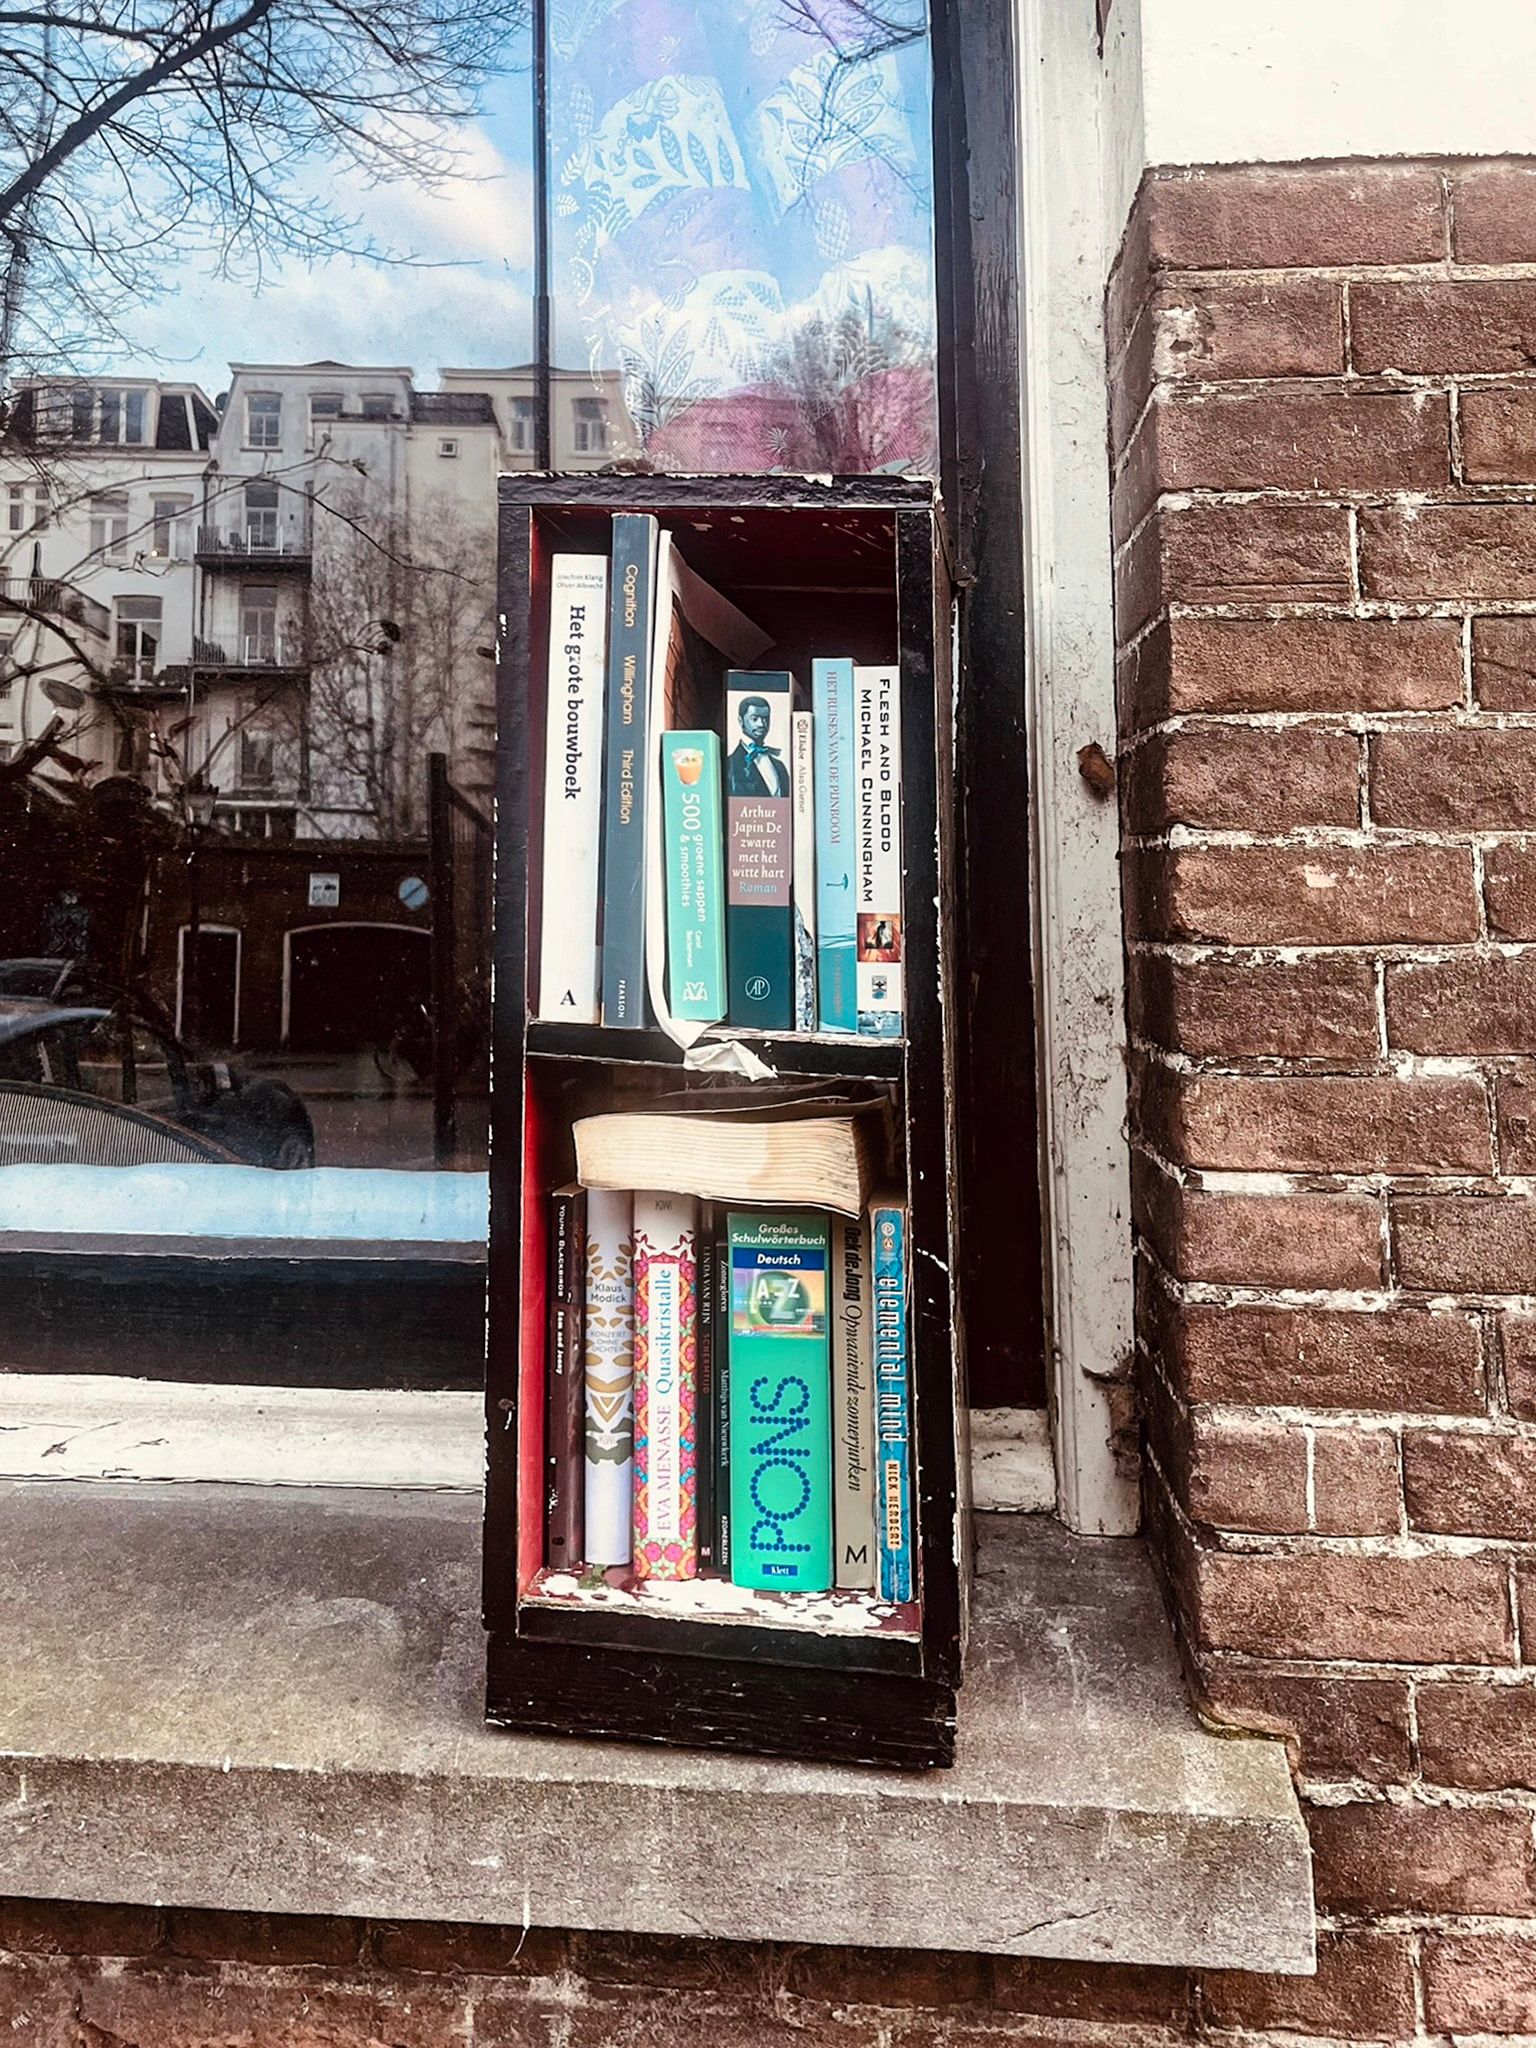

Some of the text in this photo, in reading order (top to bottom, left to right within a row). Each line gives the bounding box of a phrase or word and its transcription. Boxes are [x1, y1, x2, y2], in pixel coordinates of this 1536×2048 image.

[584, 573, 603, 582] Klang
[623, 564, 638, 627] Cognition
[570, 605, 585, 639] Het
[620, 655, 636, 725] Willingham
[565, 699, 584, 799] bouwboek
[826, 671, 840, 844] HET RUISEN VAN DE PIJNBOOM
[879, 678, 891, 852] FLESH AND BLOOD
[620, 749, 634, 824] Third Edition
[861, 689, 873, 902] MICHAEL CUNNINGHAM
[681, 792, 701, 830] 500
[732, 820, 782, 837] Japin De
[740, 805, 776, 818] Arthur
[738, 850, 778, 863] met het
[740, 839, 776, 848] zwarte
[680, 834, 692, 907] & smoothies
[693, 834, 706, 922] groene sappen
[732, 864, 785, 878] witte hart
[740, 881, 777, 894] Roman
[560, 989, 576, 1006] A
[618, 979, 626, 1018] PEARSON
[558, 1204, 566, 1237] YOUNG
[732, 1232, 826, 1245] Schulwörterbuch
[758, 1223, 799, 1234] Großes
[844, 1227, 862, 1252] Oek
[757, 1253, 801, 1265] Deutsch
[590, 1294, 627, 1303] Modick
[595, 1283, 623, 1293] Klaus
[701, 1246, 711, 1324] LINDA VAN RIJN
[842, 1266, 863, 1302] Jong
[878, 1277, 905, 1381] elemental
[655, 1269, 673, 1531] EVA MENASSE Quasikristalle
[840, 1304, 867, 1492] Opwaaiende zomerjurken
[880, 1392, 907, 1442] mind
[750, 1375, 811, 1552] PONS
[888, 1463, 900, 1546] NICK HERBERT
[845, 1545, 867, 1564] M
